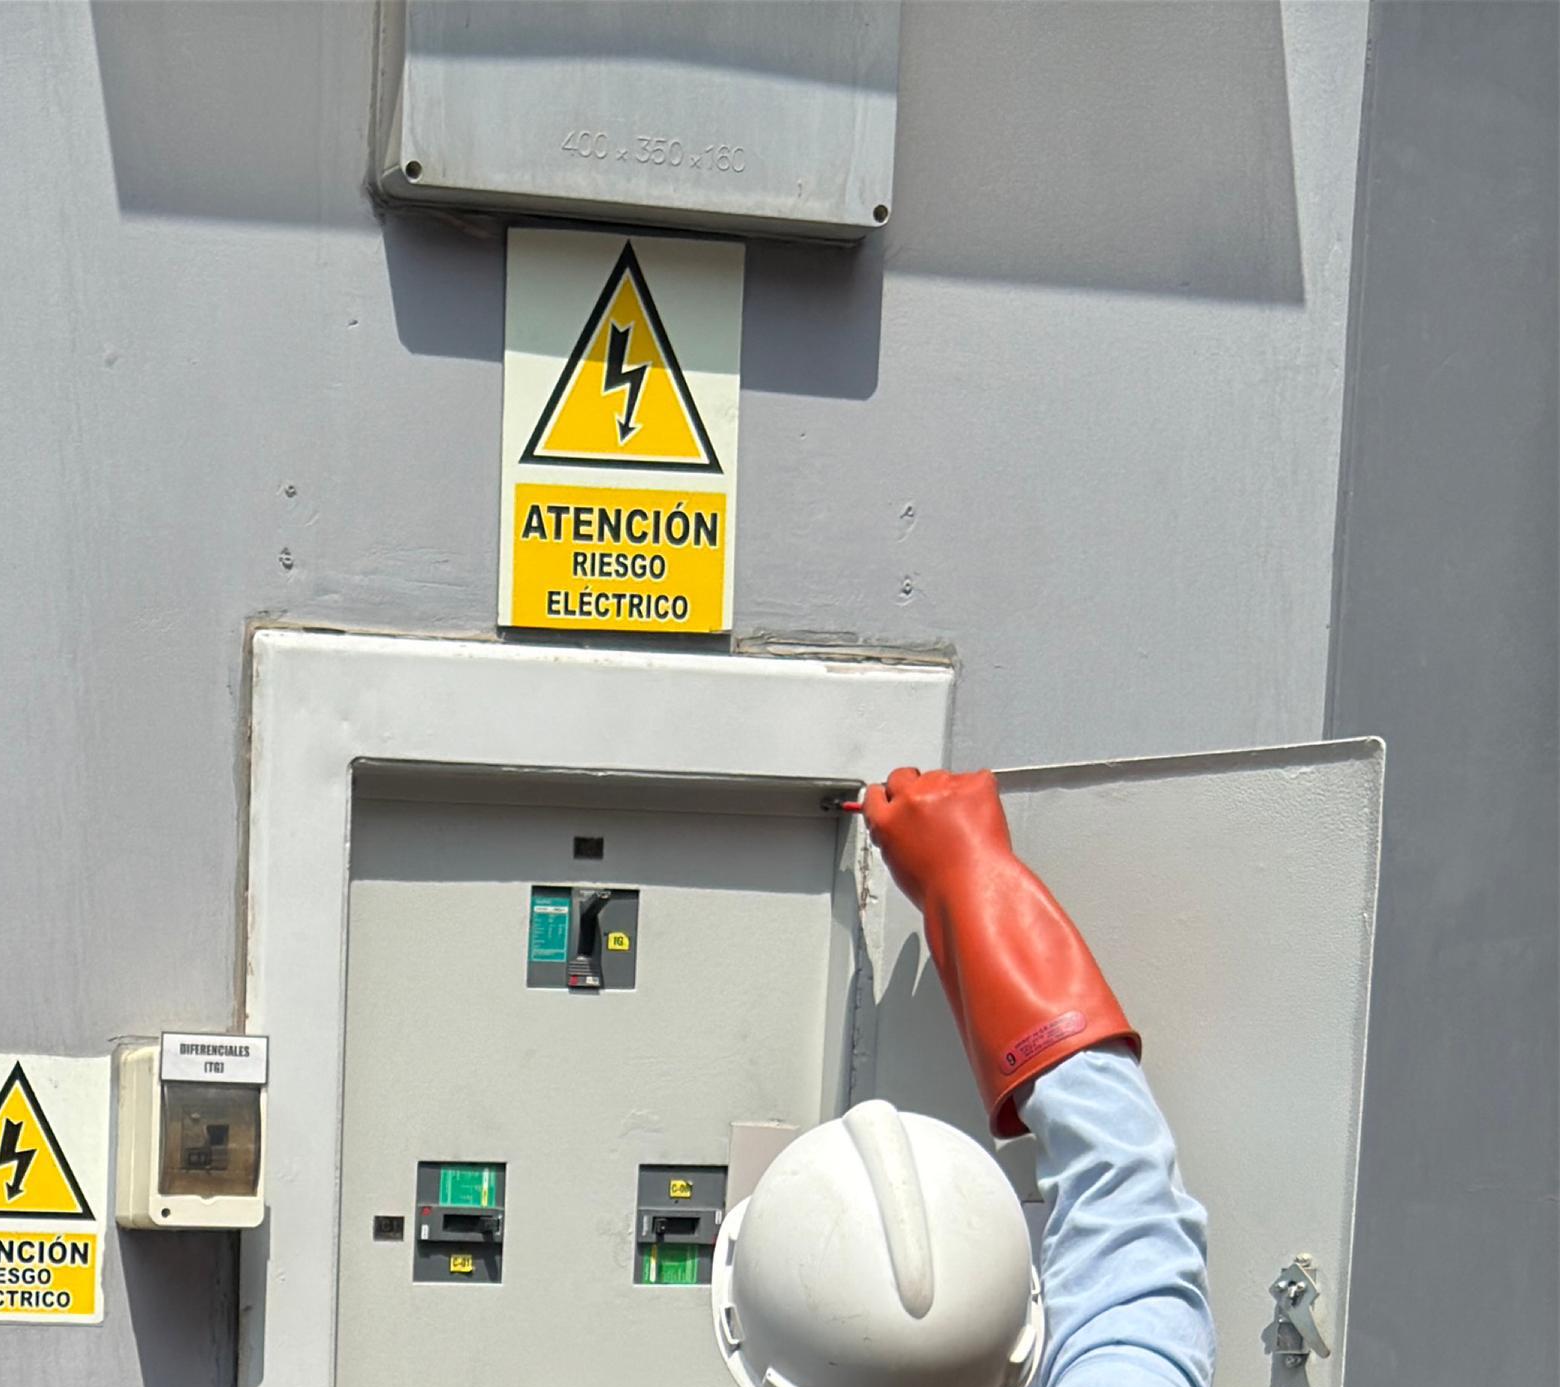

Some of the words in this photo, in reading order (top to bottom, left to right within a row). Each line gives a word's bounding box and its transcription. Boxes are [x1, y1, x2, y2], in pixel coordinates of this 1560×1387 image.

[560, 130, 608, 160] 400
[635, 136, 683, 167] 350
[704, 145, 746, 174] 160
[521, 501, 719, 547] ATENCIÓN
[572, 551, 666, 580] RIESGO
[546, 585, 689, 620] ELÉCTRICO
[179, 1043, 251, 1058] DIFERENCIALES
